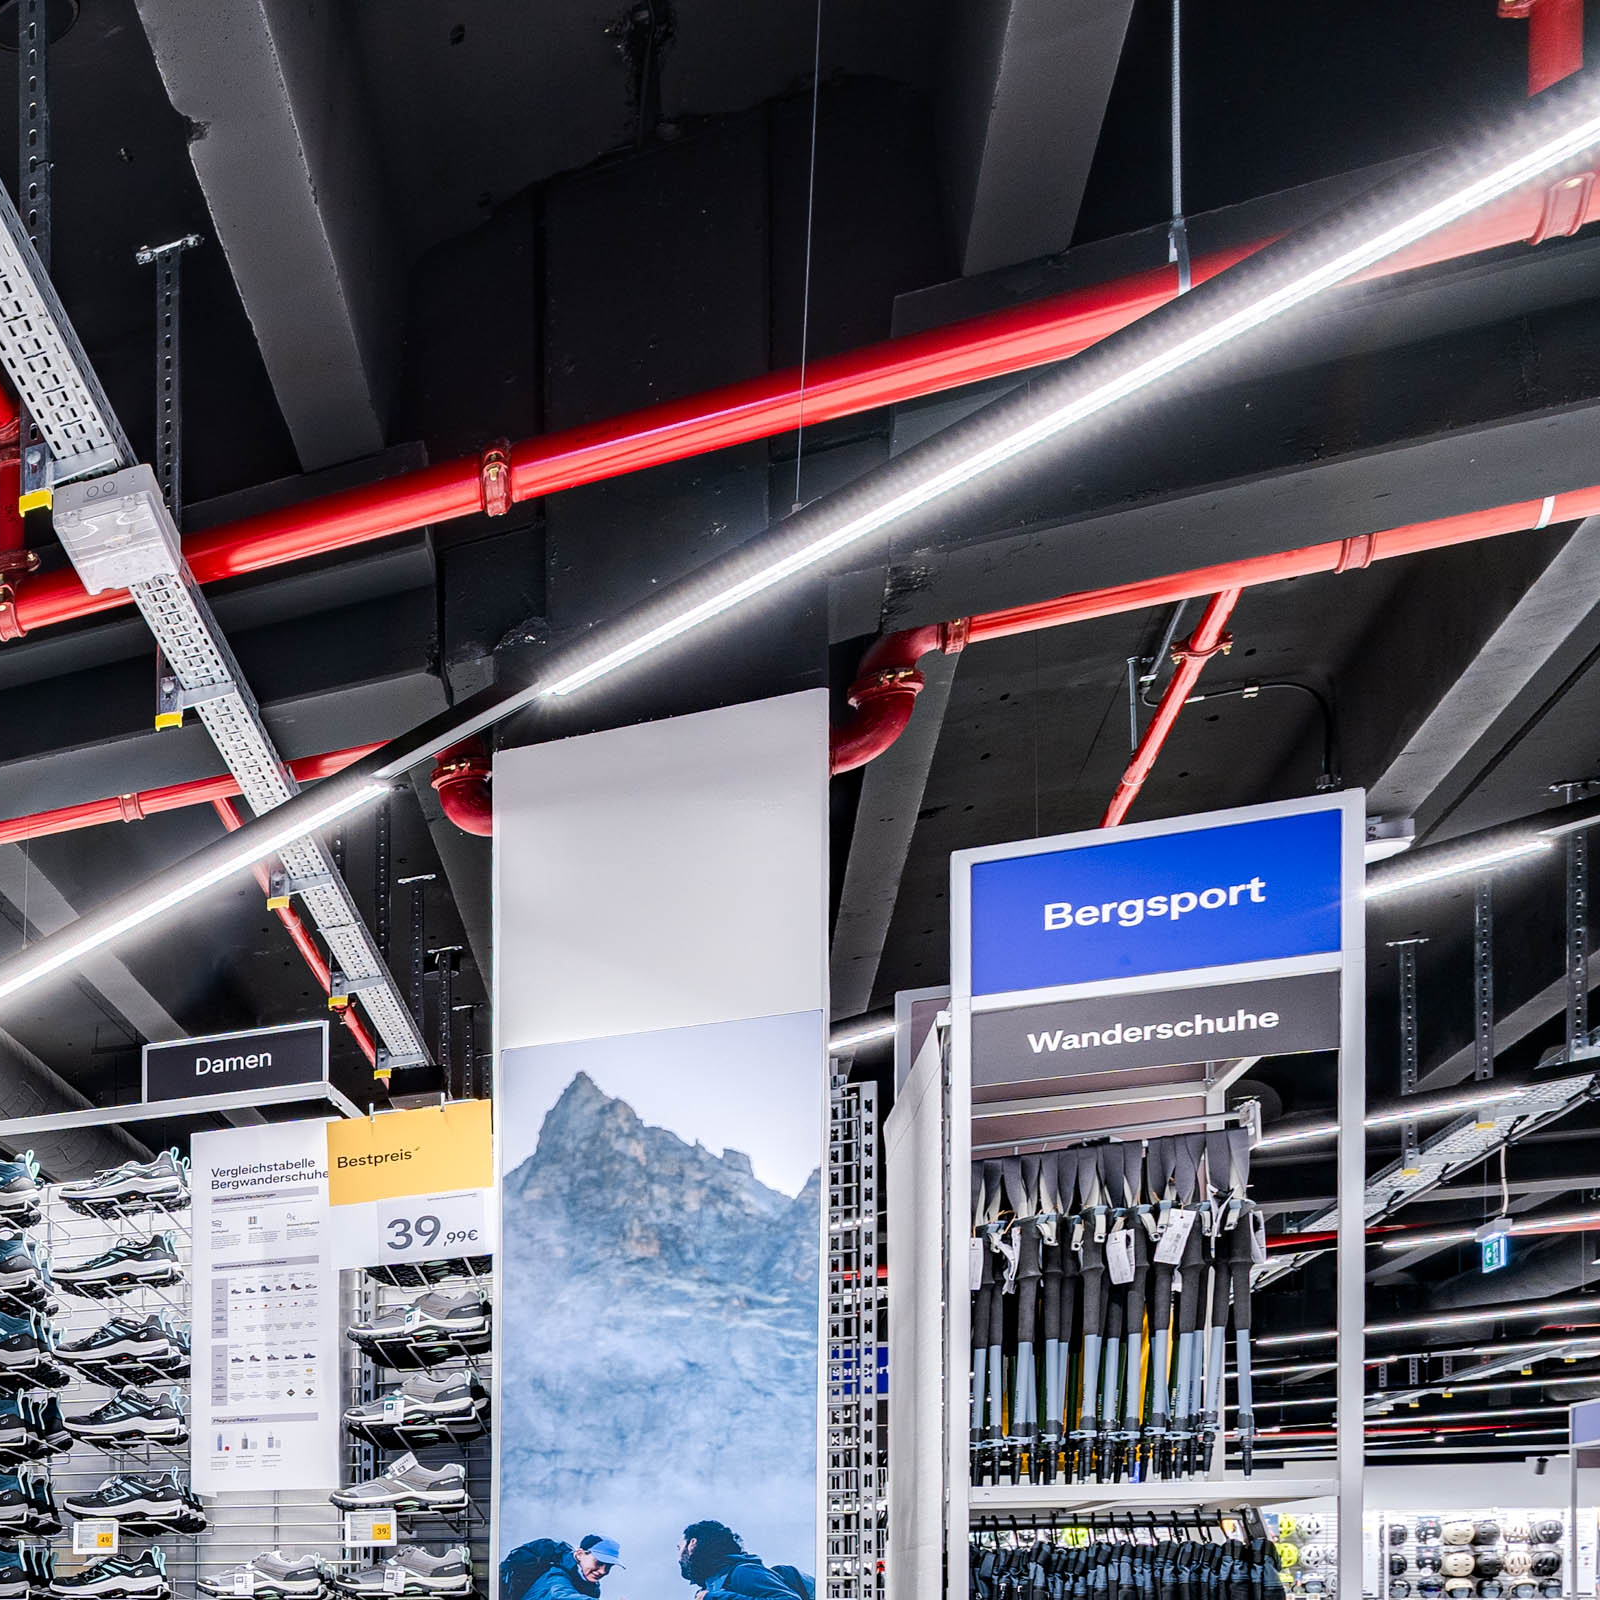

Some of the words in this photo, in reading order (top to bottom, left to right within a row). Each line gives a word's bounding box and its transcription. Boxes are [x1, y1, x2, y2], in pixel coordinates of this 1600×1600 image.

[1042, 875, 1267, 932] Bergsport
[1027, 1007, 1280, 1055] Wanderschuhe
[195, 1049, 273, 1077] Damen
[211, 1158, 316, 1179] Vergleichstabelle
[337, 1148, 412, 1169] Bestpreis
[211, 1169, 328, 1191] Bergwanderschuhe
